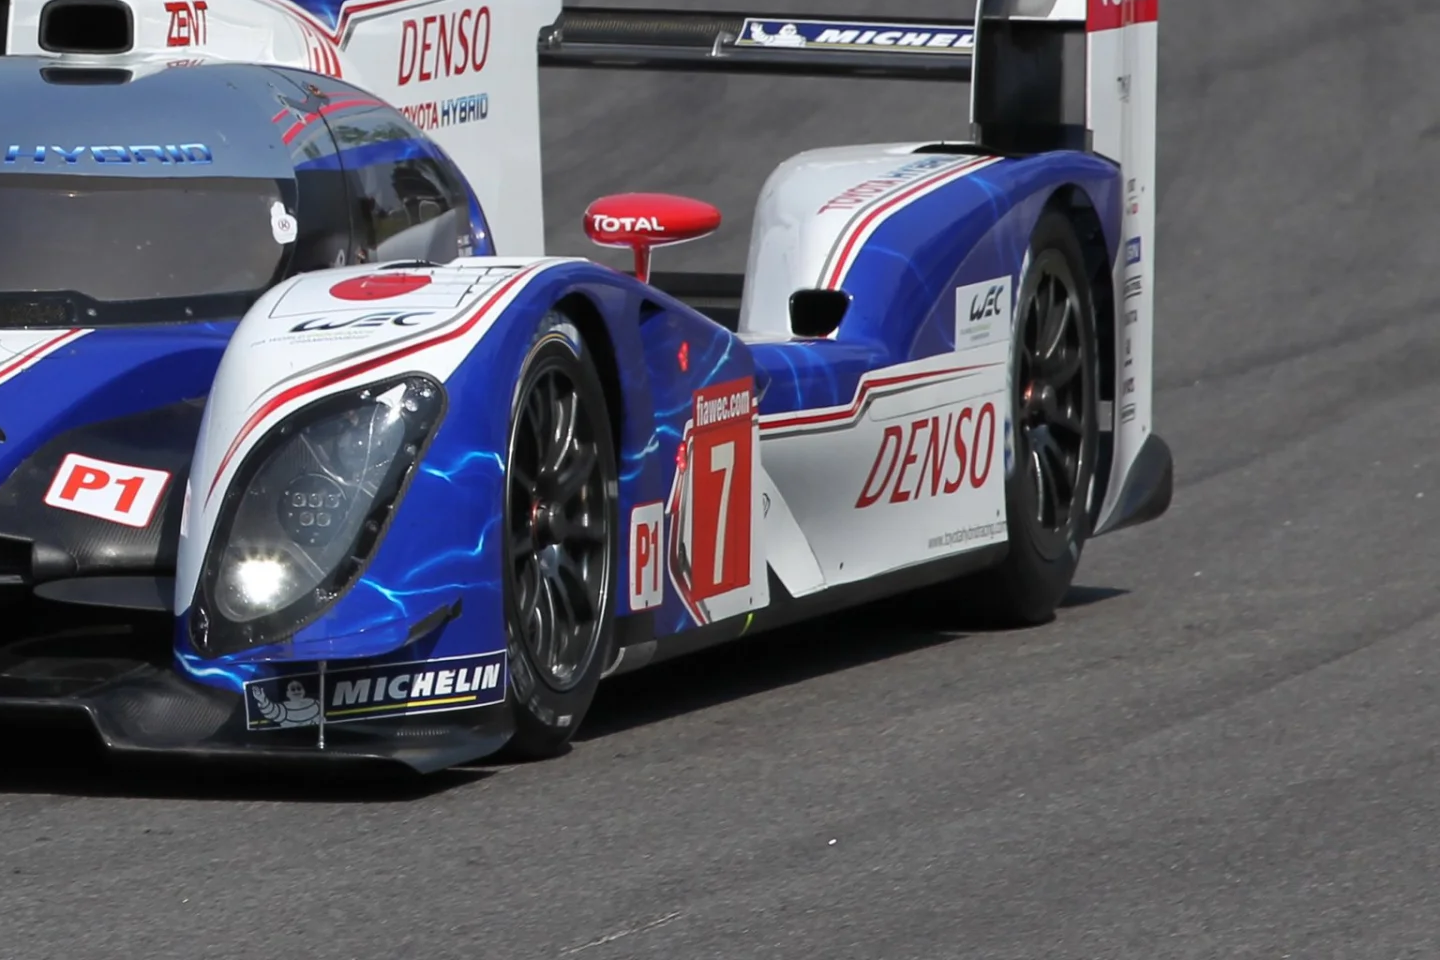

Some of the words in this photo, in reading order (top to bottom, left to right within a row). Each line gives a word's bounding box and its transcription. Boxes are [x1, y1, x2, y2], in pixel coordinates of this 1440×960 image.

[164, 0, 208, 47] ZENT
[815, 28, 974, 48] MICHEL
[397, 5, 491, 86] DENSO
[441, 93, 489, 128] HYBRID
[3, 143, 214, 165] HYBRID
[592, 214, 666, 232] TOTAL
[289, 311, 436, 334] WEC
[969, 285, 1005, 322] WEC
[696, 390, 751, 427] fiawec.com
[854, 402, 996, 509] DENSO
[60, 464, 144, 513] P1
[710, 441, 736, 585] 7
[635, 521, 659, 596] P1
[332, 663, 501, 707] MICHELIN
